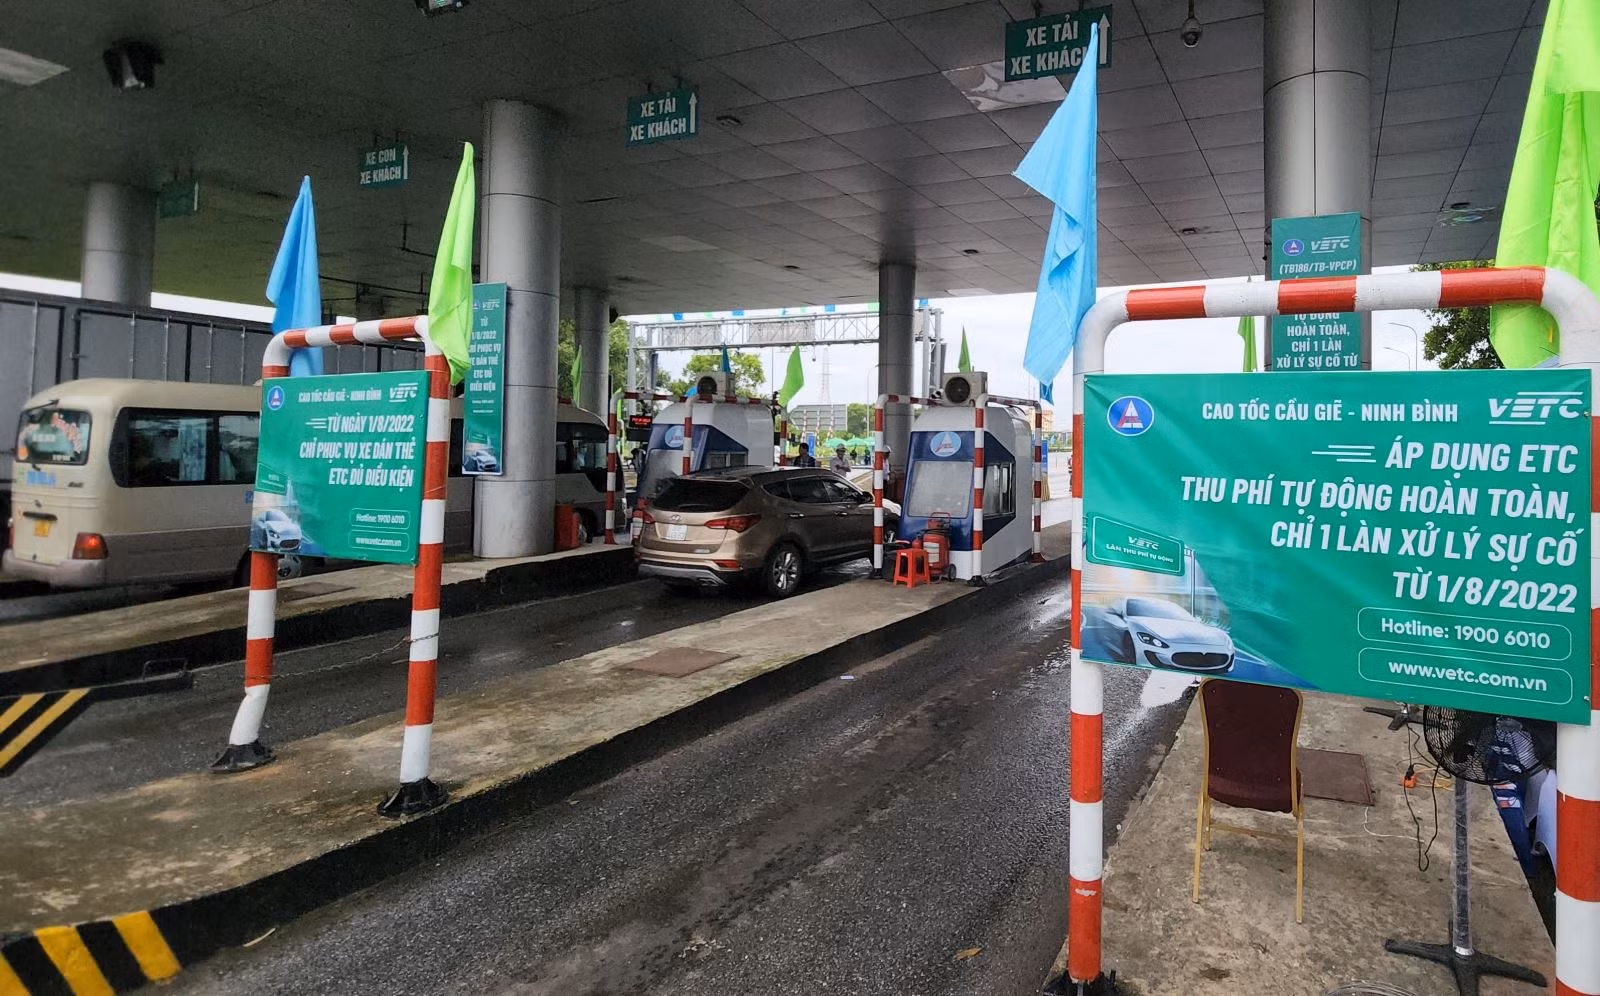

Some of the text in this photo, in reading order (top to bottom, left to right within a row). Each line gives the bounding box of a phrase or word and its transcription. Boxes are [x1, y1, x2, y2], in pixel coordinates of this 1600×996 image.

[1026, 14, 1078, 47] XE TẢI
[1010, 56, 1032, 76] XE
[640, 101, 655, 118] XE
[630, 117, 686, 141] XE KHÁCH
[366, 147, 396, 165] XE CON
[360, 165, 402, 184] XE KHÁCH
[1310, 237, 1350, 252] VETC
[1280, 259, 1357, 274] (TB186/TB-VPCP)
[1287, 321, 1350, 336] HOÀN TOÀN,
[1292, 337, 1342, 352] CHỈ 1 LÀN
[1276, 352, 1358, 370] XỬ LÝ SỰ CỐ TỪ
[389, 384, 418, 401] VETC
[1202, 403, 1234, 420] CAO
[1238, 398, 1270, 420] TỐC
[1274, 398, 1309, 421] CẦU
[1314, 400, 1342, 422] GIẼ
[1361, 404, 1405, 422] NINH
[1412, 399, 1458, 422] BÌNH
[1488, 394, 1584, 422] VETC
[328, 412, 414, 432] TỪ NGÀY 1/8/2022
[300, 437, 317, 459] CHỈ
[316, 442, 342, 464] PHỤC
[344, 442, 358, 464] VỤ
[358, 442, 372, 460] XE
[395, 436, 416, 460] THẺ
[1385, 435, 1579, 479] ÁP DỤNG ETC
[328, 468, 348, 484] ETC
[388, 465, 414, 492] KIỆN
[1181, 474, 1576, 524] THU PHÍ TỰ ĐỘNG HOÀN TOÀN,
[1128, 537, 1159, 550] VETC
[1270, 515, 1584, 572] CHỈ 1 LÀN XỬ LÝ SỰ CỐ
[1394, 566, 1578, 613] TỪ 1/8/2022
[1381, 618, 1551, 650] Hotline: 1900 6010
[1388, 660, 1547, 692] www.vetc.com.vn
